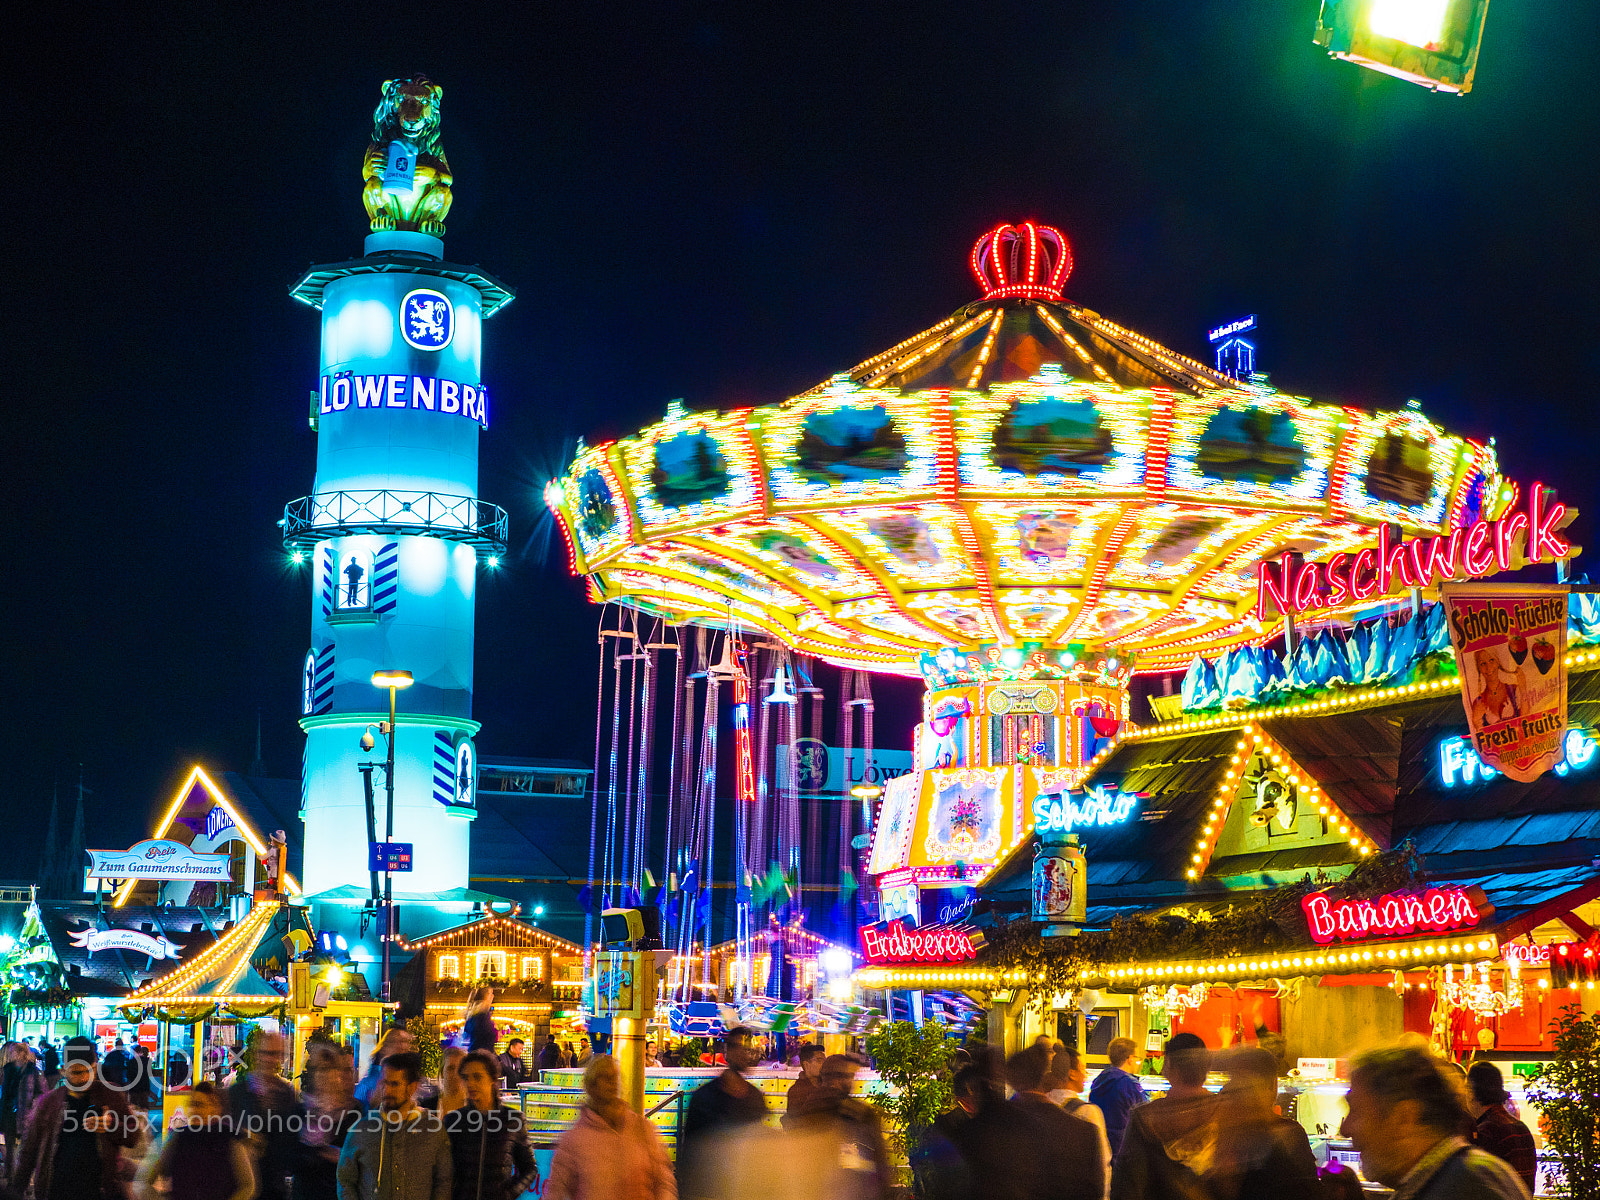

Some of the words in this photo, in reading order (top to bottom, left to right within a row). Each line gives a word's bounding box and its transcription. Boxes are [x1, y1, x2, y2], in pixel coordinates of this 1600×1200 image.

[320, 370, 488, 430] LÖWENBRÄ
[1257, 481, 1569, 621] Naschwerk
[1475, 724, 1517, 753] Fresh
[1521, 713, 1562, 738] fruits
[1033, 783, 1138, 834] Schoko
[99, 861, 125, 872] Zum
[128, 861, 222, 874] Gaumenschmaus
[860, 920, 976, 960] Erdbeeren
[1303, 888, 1481, 942] Bananen
